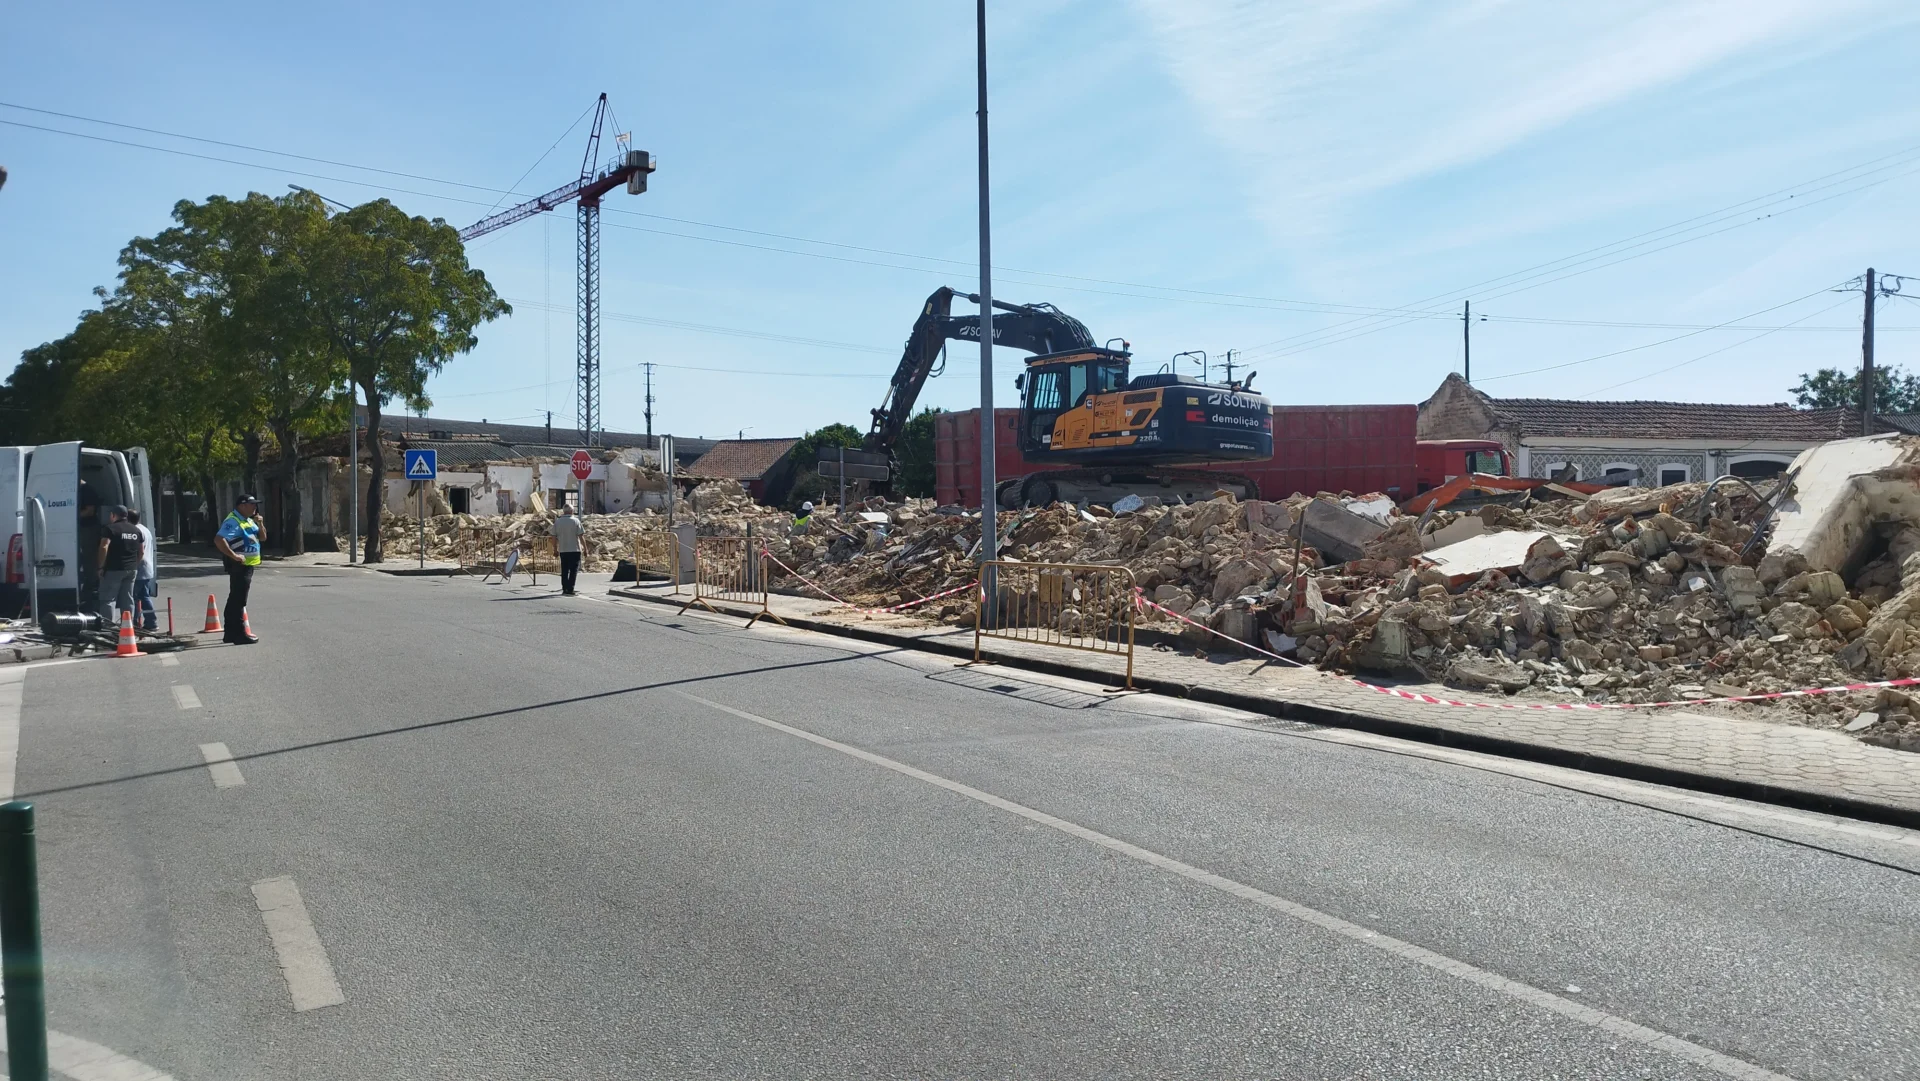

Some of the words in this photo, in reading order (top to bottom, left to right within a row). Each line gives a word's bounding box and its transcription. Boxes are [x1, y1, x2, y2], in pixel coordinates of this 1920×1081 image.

[970, 326, 1002, 338] SOAV
[1223, 394, 1261, 411] SOLTAV
[1212, 413, 1259, 427] demolição
[572, 460, 592, 471] STOP
[122, 533, 138, 541] MEO
